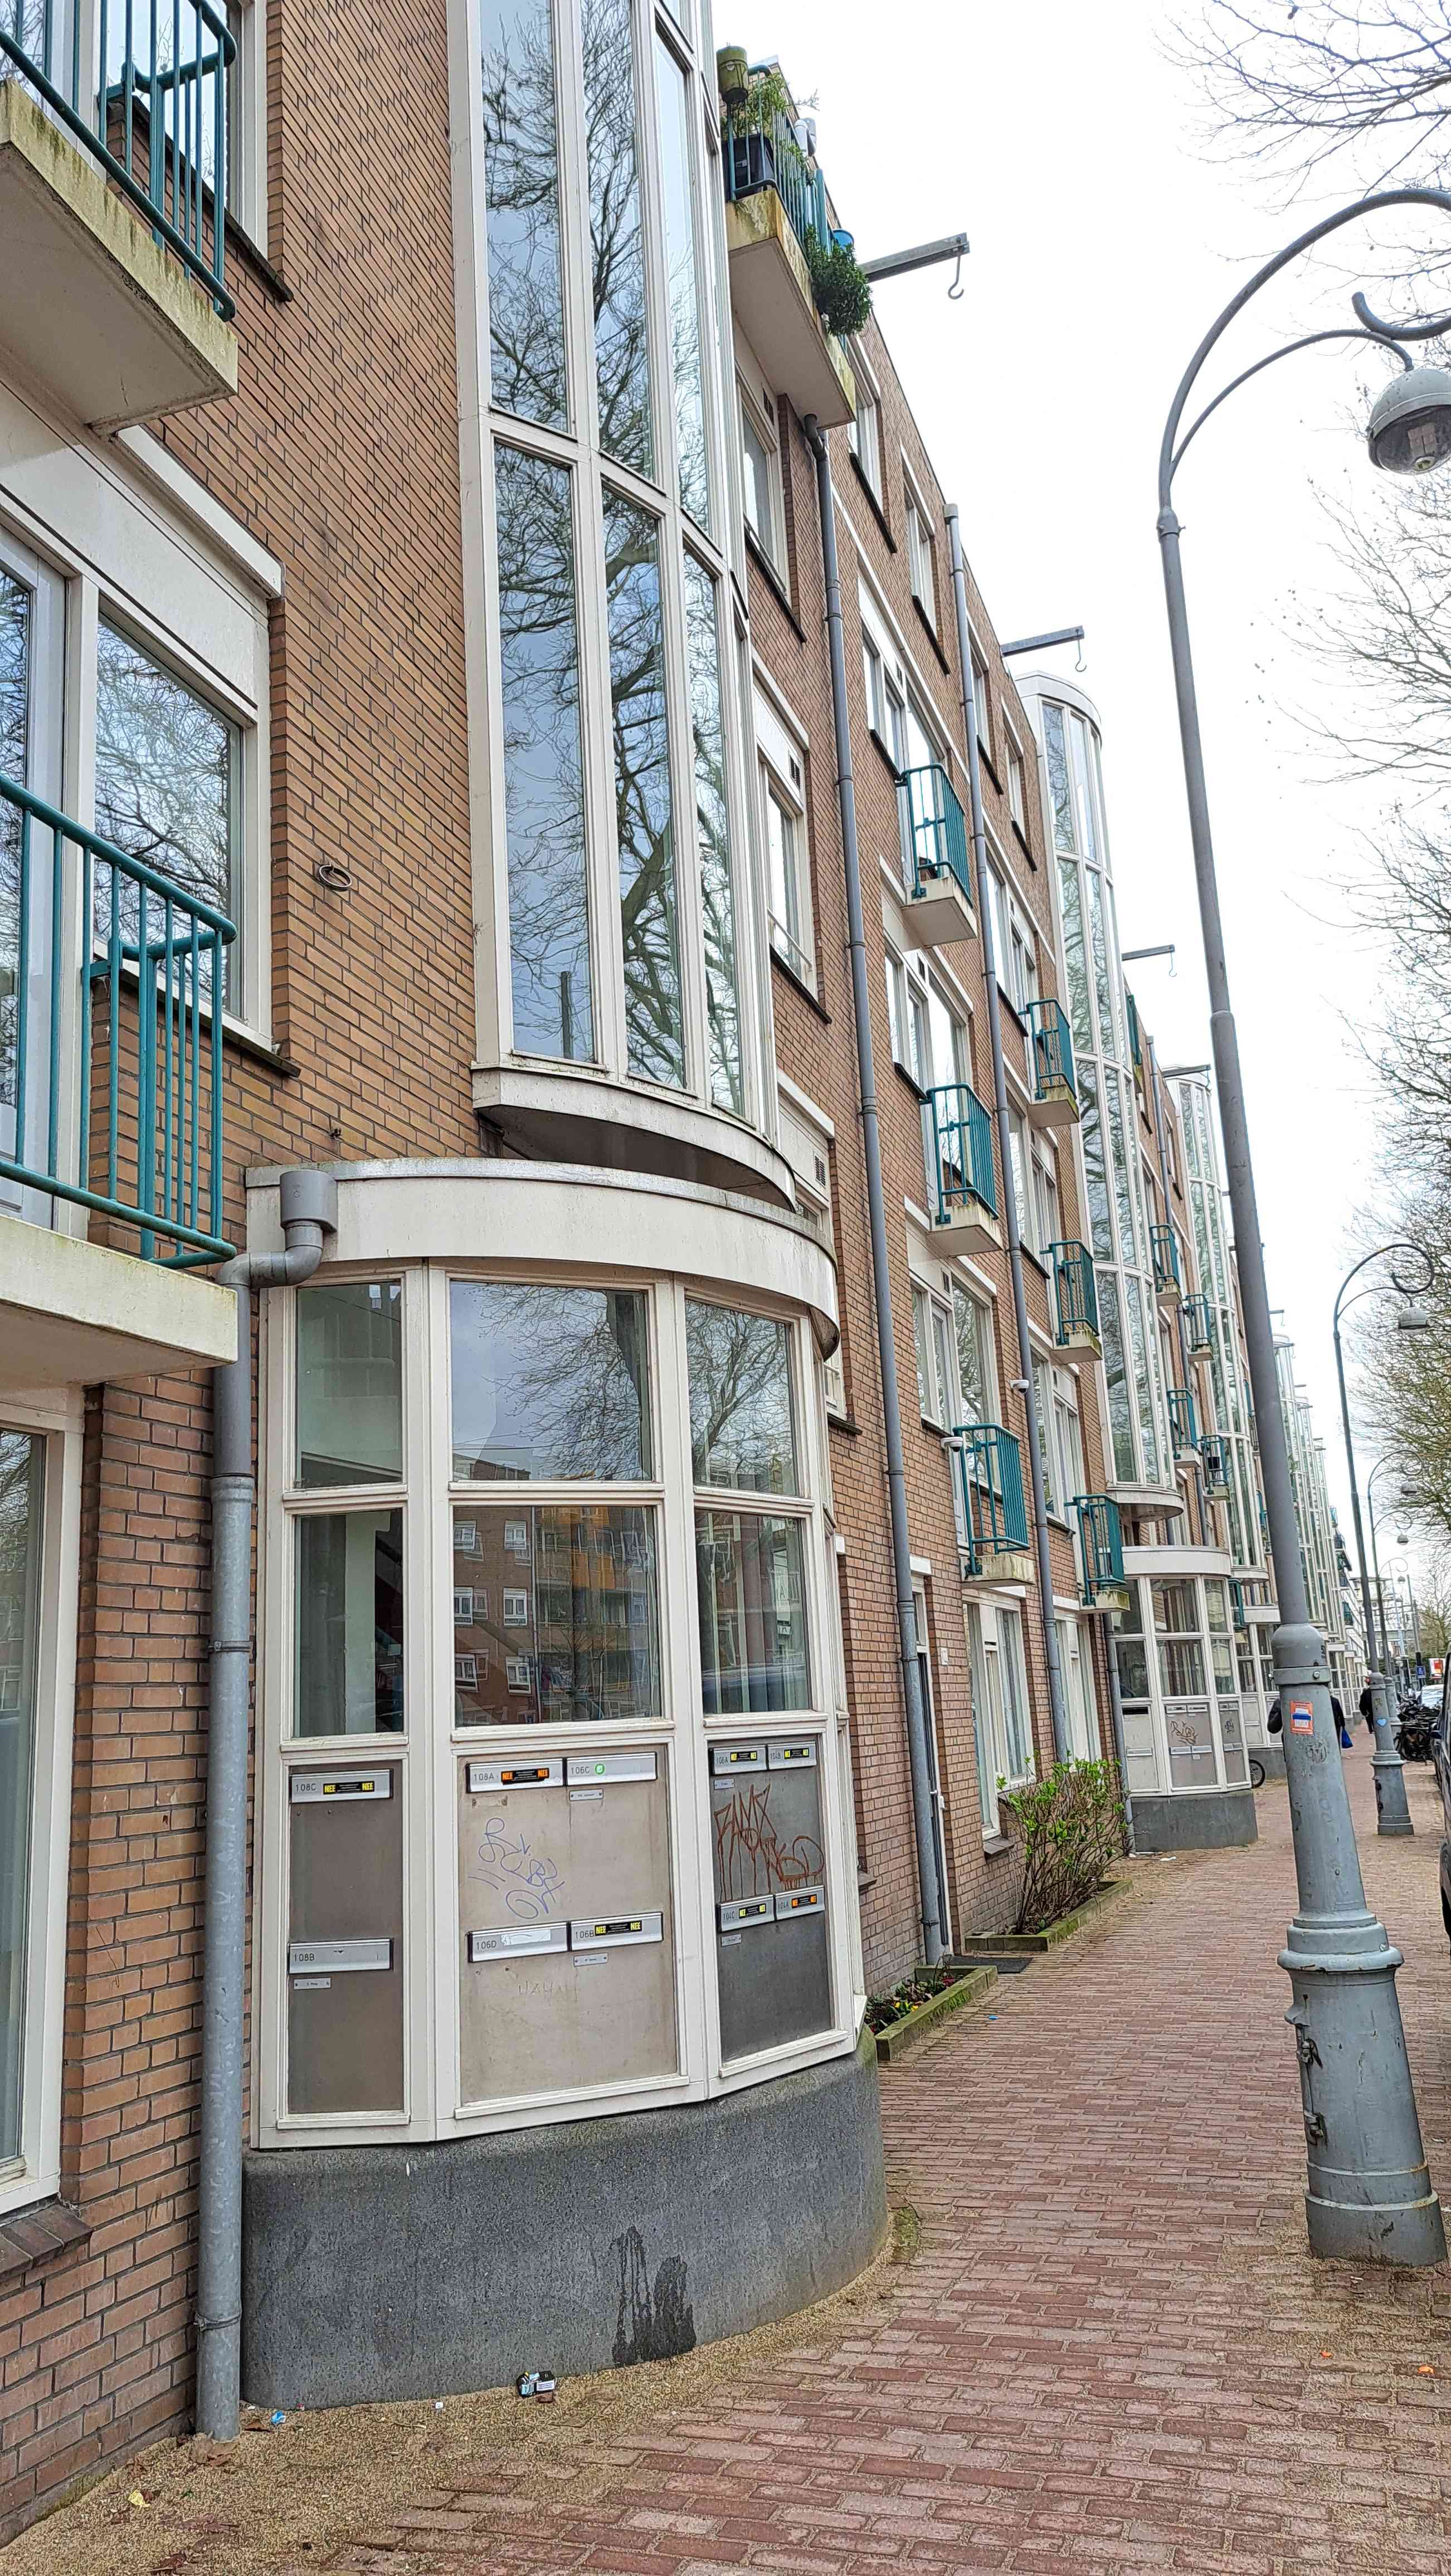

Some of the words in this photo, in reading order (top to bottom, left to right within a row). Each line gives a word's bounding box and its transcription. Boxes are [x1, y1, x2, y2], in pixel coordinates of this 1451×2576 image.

[502, 1772, 513, 1780] NEE
[537, 1769, 549, 1778] NEE
[571, 1766, 590, 1774] 106C
[474, 1773, 495, 1781] 108A
[296, 1783, 317, 1792] 108C
[324, 1784, 336, 1793] NEE
[362, 1782, 374, 1791] NEE
[596, 1925, 607, 1934] NEE
[630, 1921, 641, 1931] NEE
[575, 1930, 595, 1939] 106B
[476, 1940, 497, 1950] 106D
[294, 1953, 315, 1962] 108B
